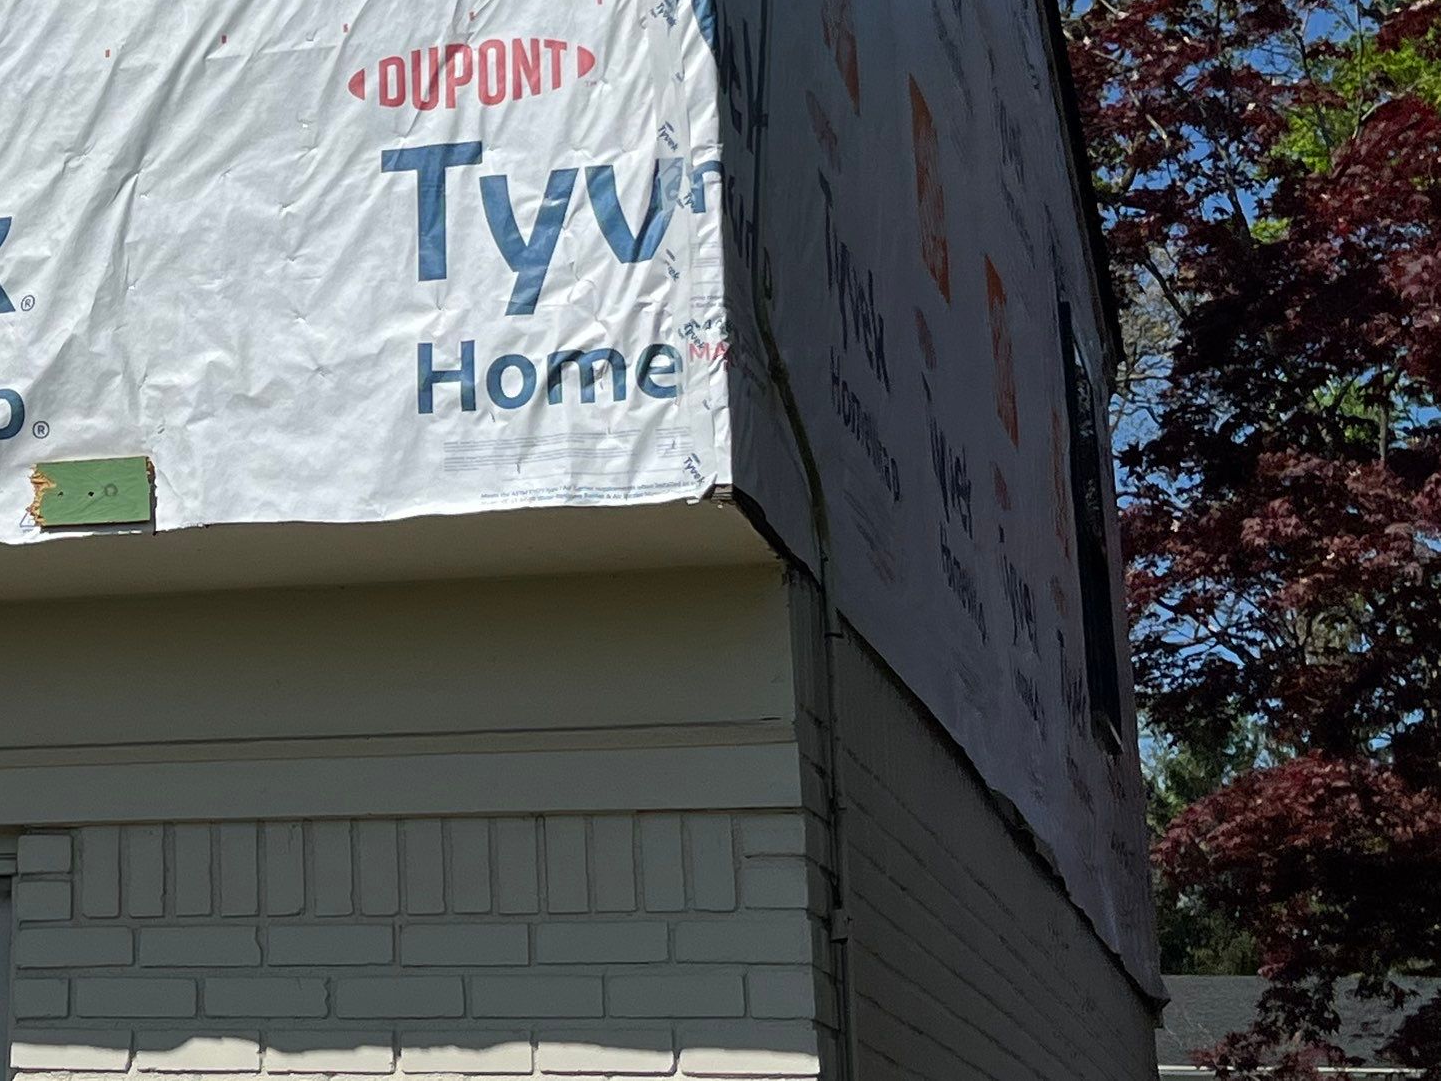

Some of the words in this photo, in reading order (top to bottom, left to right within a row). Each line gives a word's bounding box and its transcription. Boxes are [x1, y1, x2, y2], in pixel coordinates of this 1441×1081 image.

[378, 38, 568, 111] DUPONT
[381, 141, 684, 316] Tyv
[418, 340, 683, 414] Home
